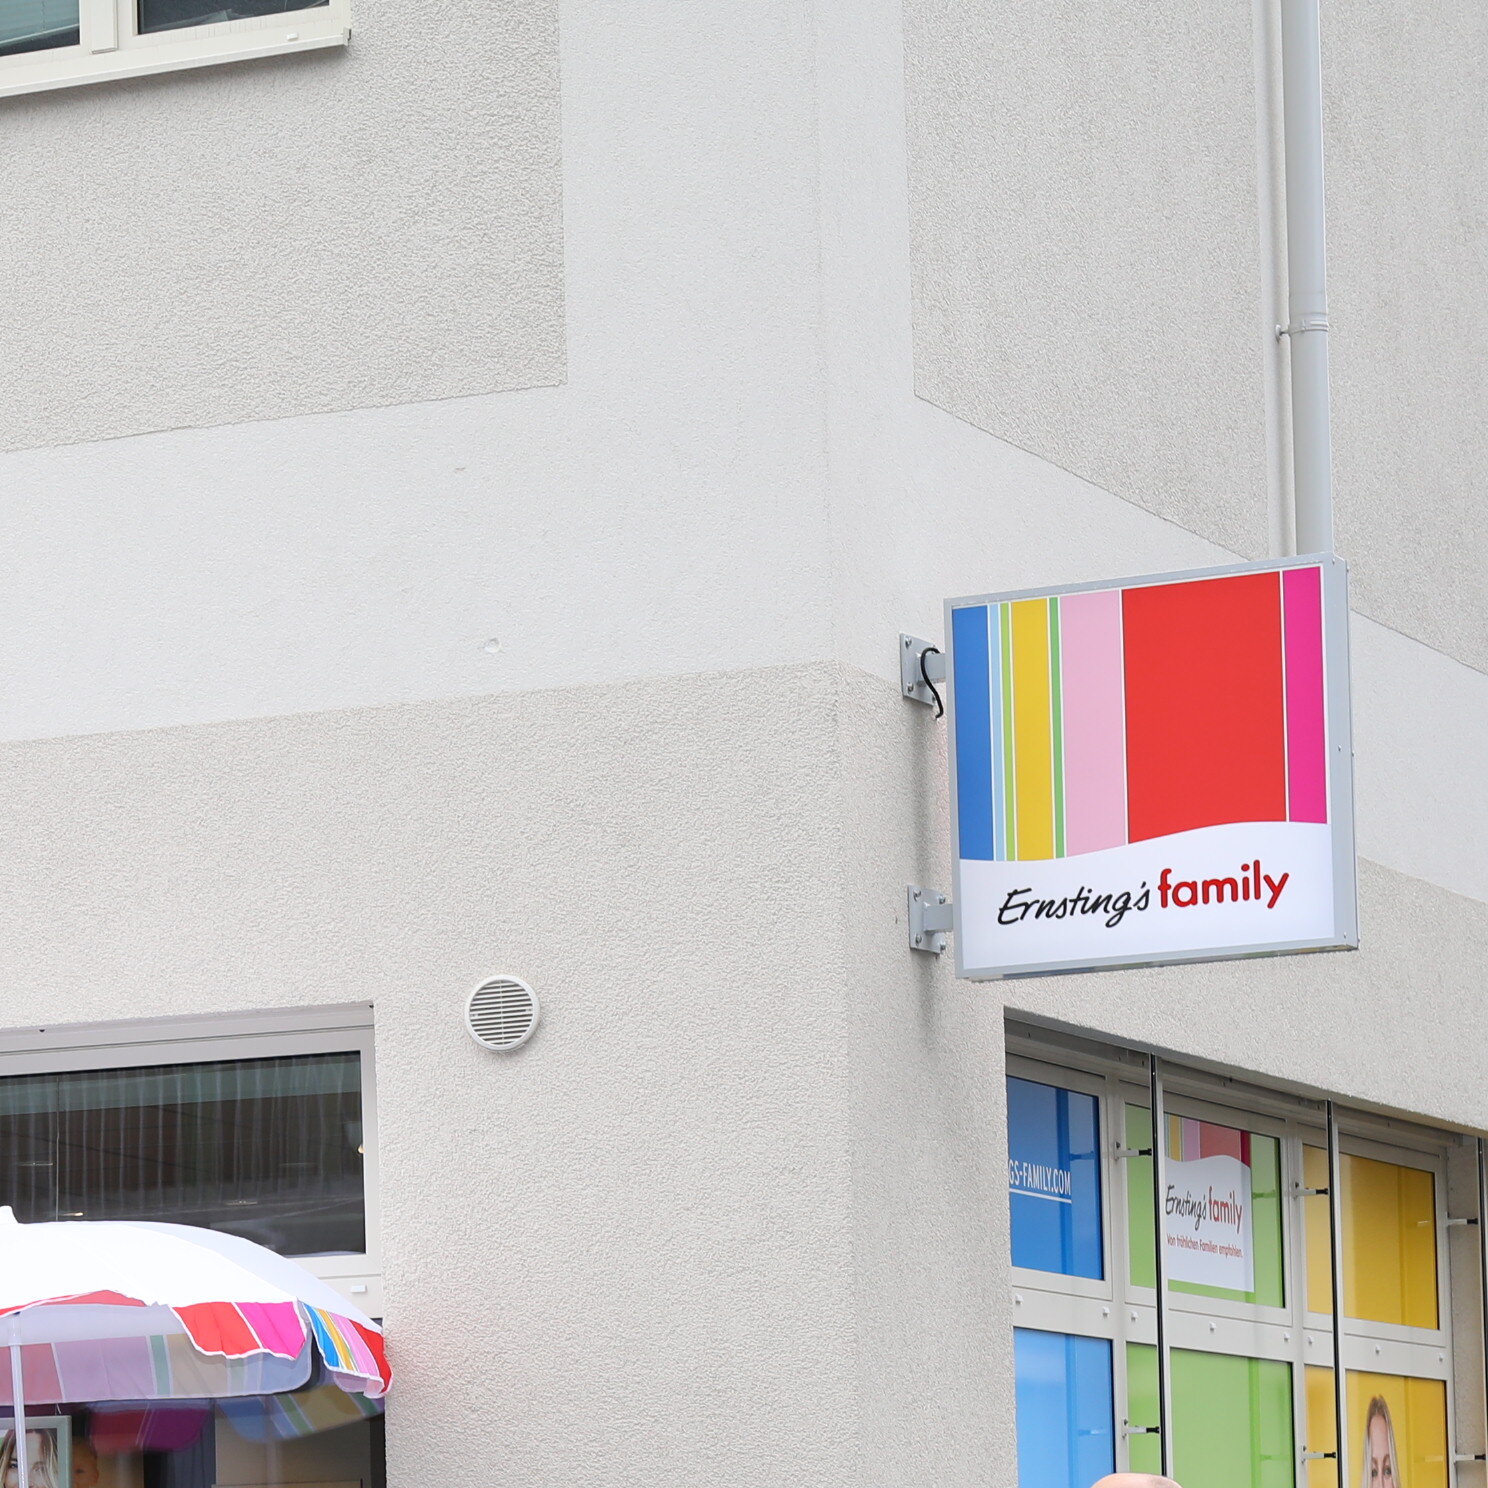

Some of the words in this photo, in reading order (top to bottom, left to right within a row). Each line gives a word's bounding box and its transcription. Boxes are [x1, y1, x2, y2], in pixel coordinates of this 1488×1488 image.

[997, 881, 1150, 928] Ernsting's
[1158, 859, 1290, 909] family
[1165, 1184, 1206, 1232] Ernsting's
[1208, 1186, 1242, 1234] family
